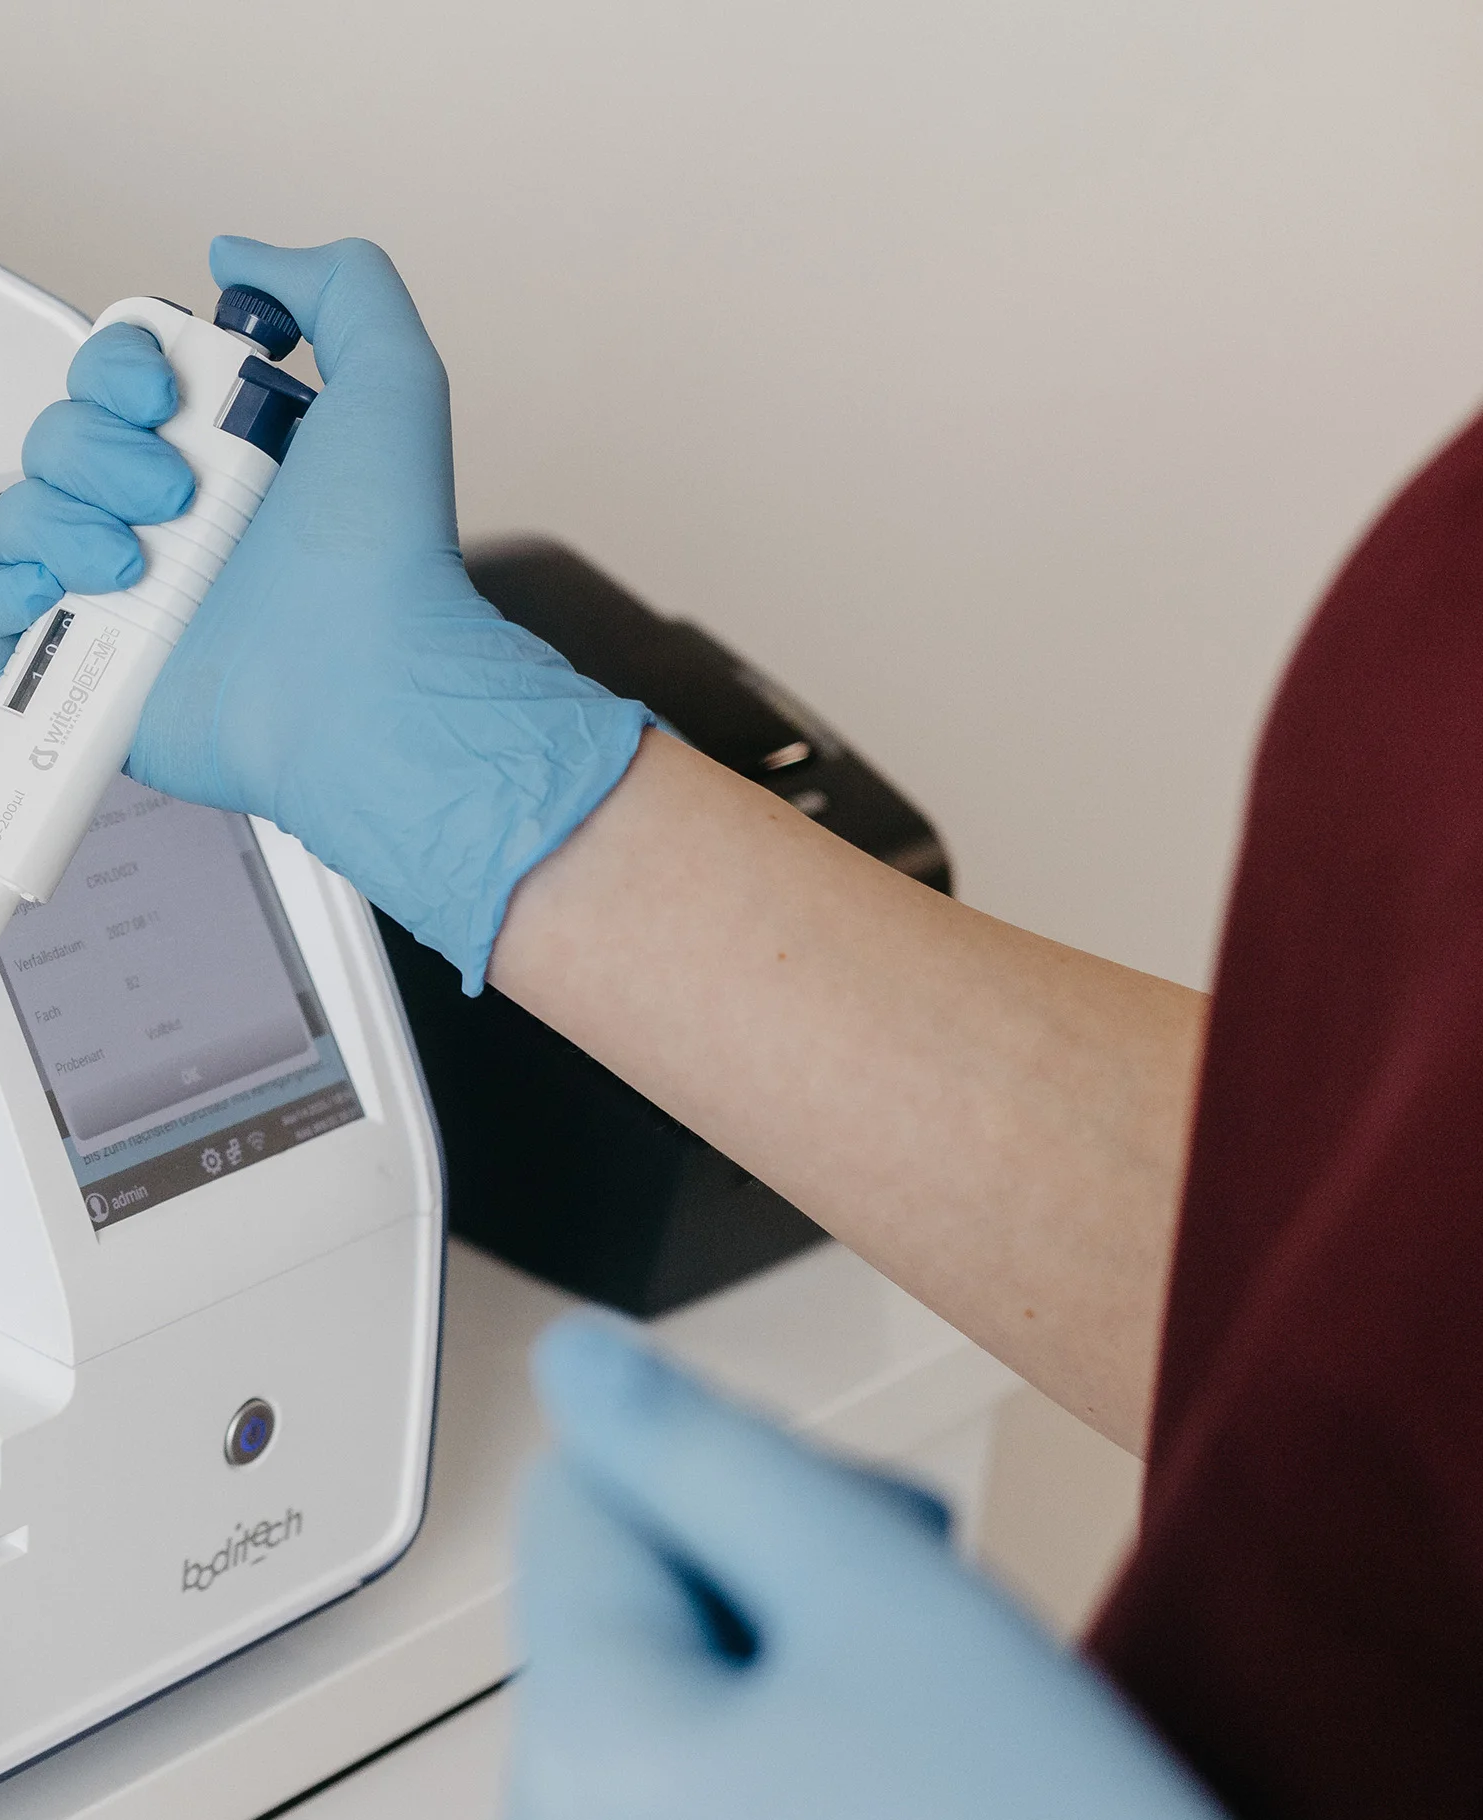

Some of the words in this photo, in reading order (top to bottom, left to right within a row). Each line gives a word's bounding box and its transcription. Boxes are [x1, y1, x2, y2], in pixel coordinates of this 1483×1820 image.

[44, 685, 89, 745] witeg
[77, 642, 111, 688] DE-M
[13, 940, 86, 973] Verfallsdatum
[34, 1005, 63, 1024] Fach
[55, 1048, 106, 1077] Probenart
[111, 1184, 149, 1211] admin
